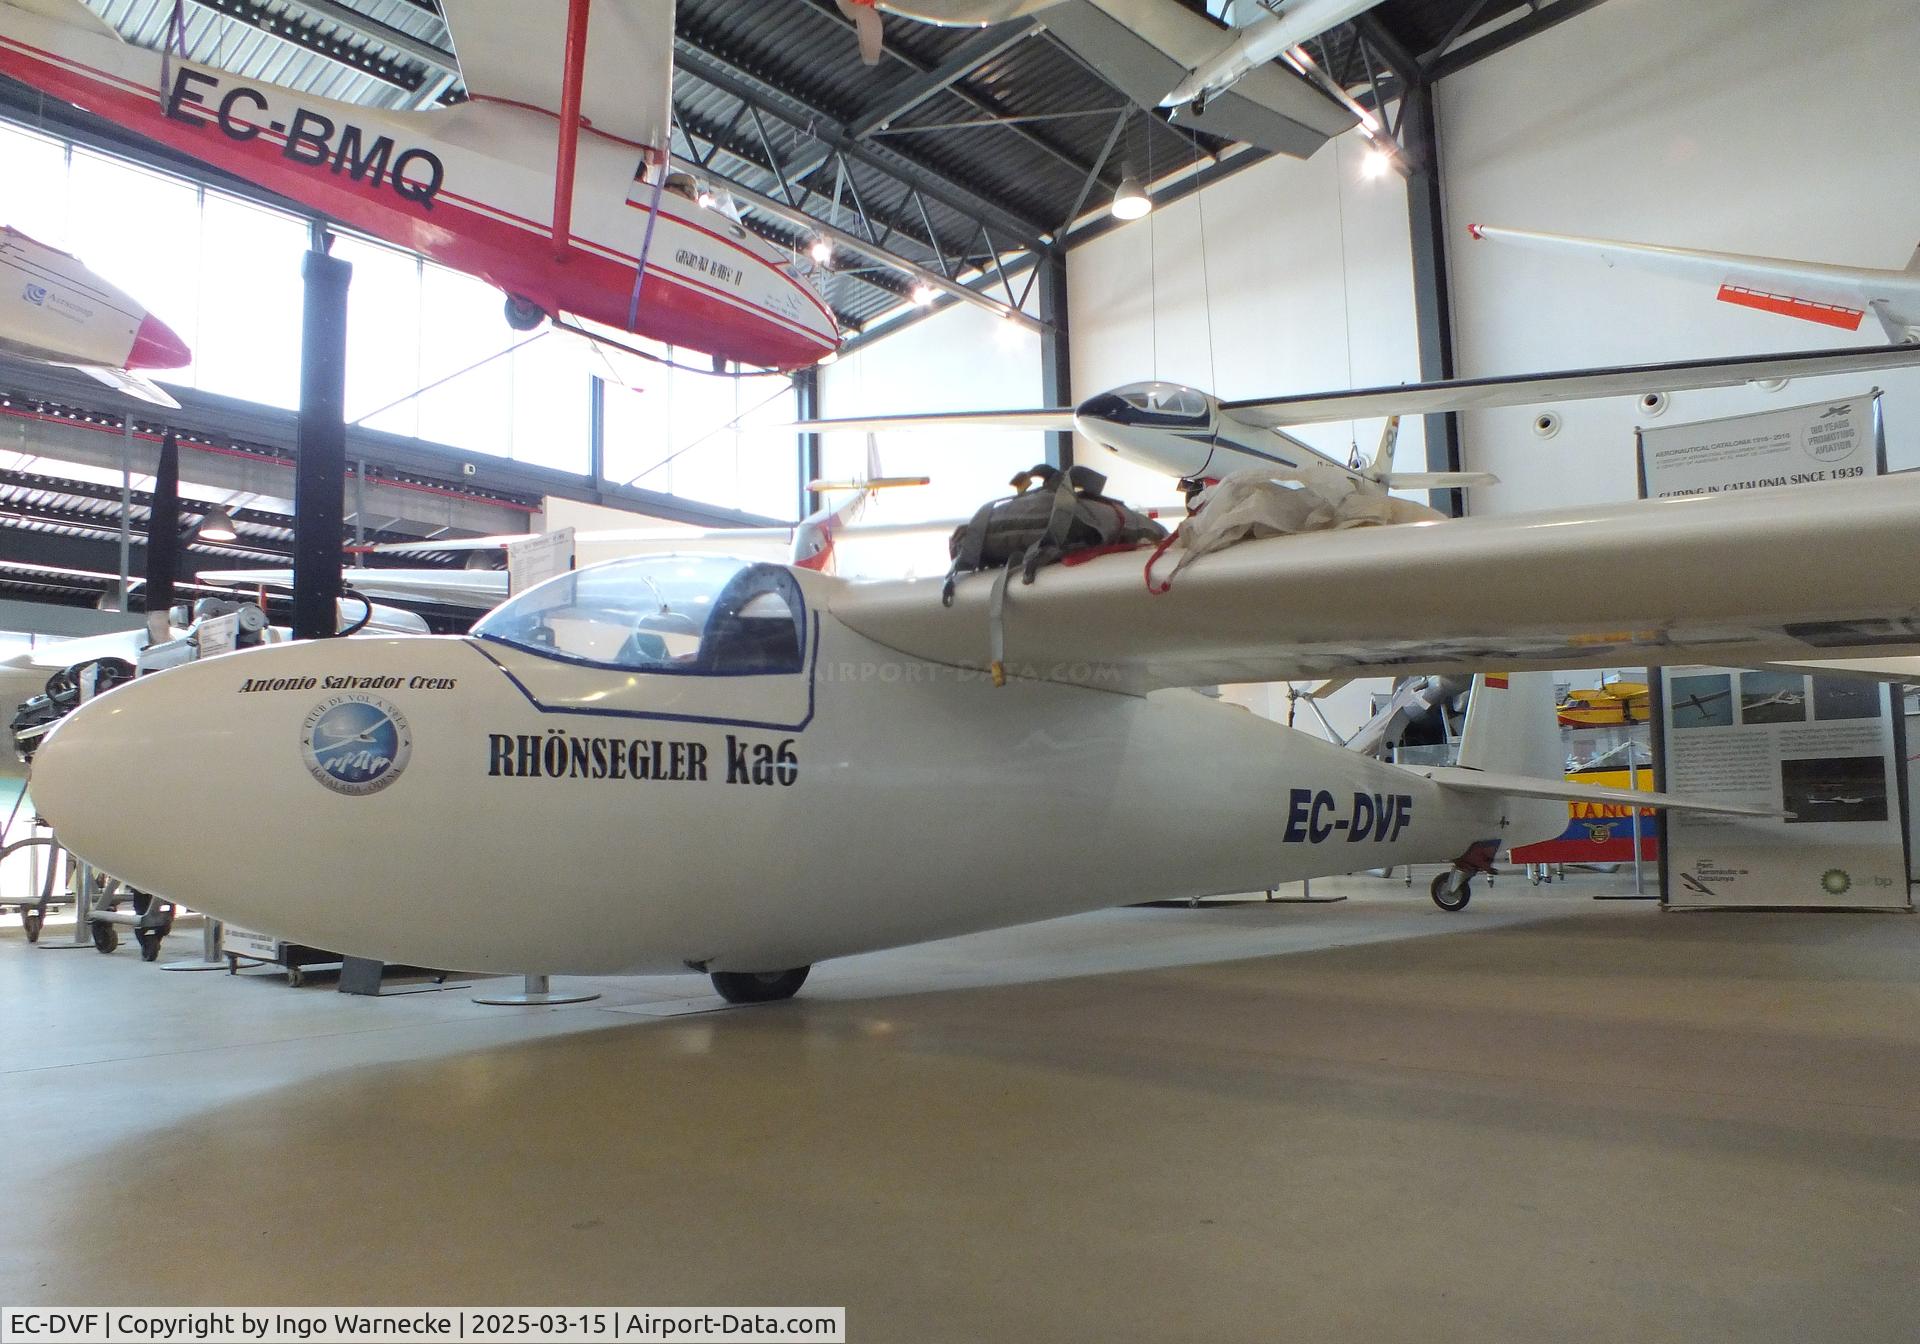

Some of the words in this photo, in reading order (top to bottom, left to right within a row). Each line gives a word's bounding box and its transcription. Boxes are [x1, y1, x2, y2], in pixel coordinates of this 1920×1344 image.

[168, 67, 444, 211] EC-BMQ
[1791, 471, 1825, 484] SINCE
[1831, 465, 1864, 480] 1939
[239, 676, 317, 693] Antonio
[321, 675, 405, 690] Salvador
[409, 675, 458, 690] Creus
[488, 728, 708, 781] RHÖNSEGLER
[1282, 788, 1413, 843] EC-DVF
